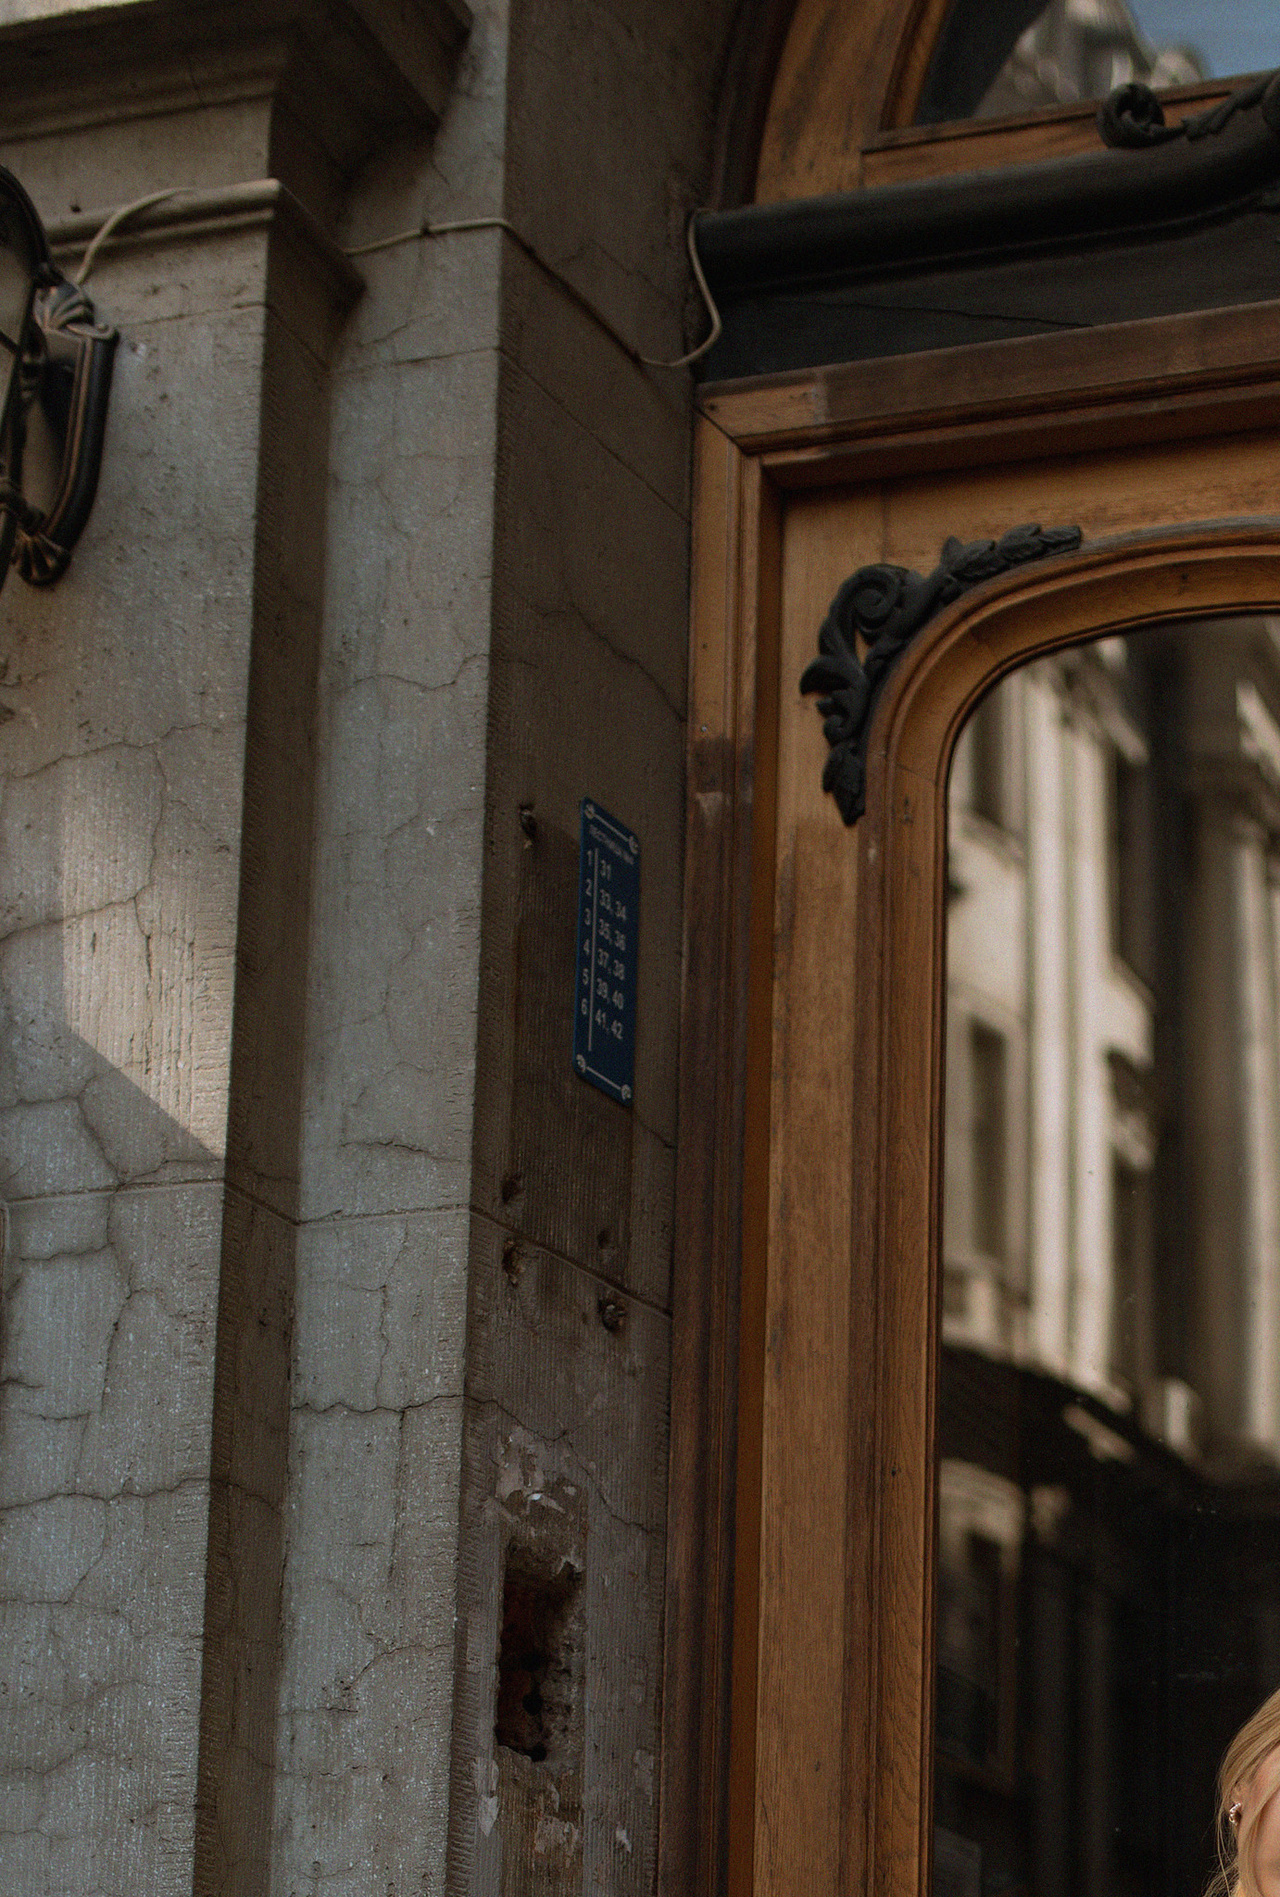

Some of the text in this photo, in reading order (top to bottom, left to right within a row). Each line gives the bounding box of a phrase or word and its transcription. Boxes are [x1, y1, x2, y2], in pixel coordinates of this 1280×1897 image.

[586, 850, 612, 880] 1 31
[585, 878, 592, 897] 2
[615, 900, 627, 920] 34
[585, 908, 591, 926] 3
[584, 939, 590, 955] 4
[582, 967, 589, 986] 5
[612, 989, 624, 1010] 40
[581, 998, 588, 1016] 6
[611, 1020, 623, 1040] 42
